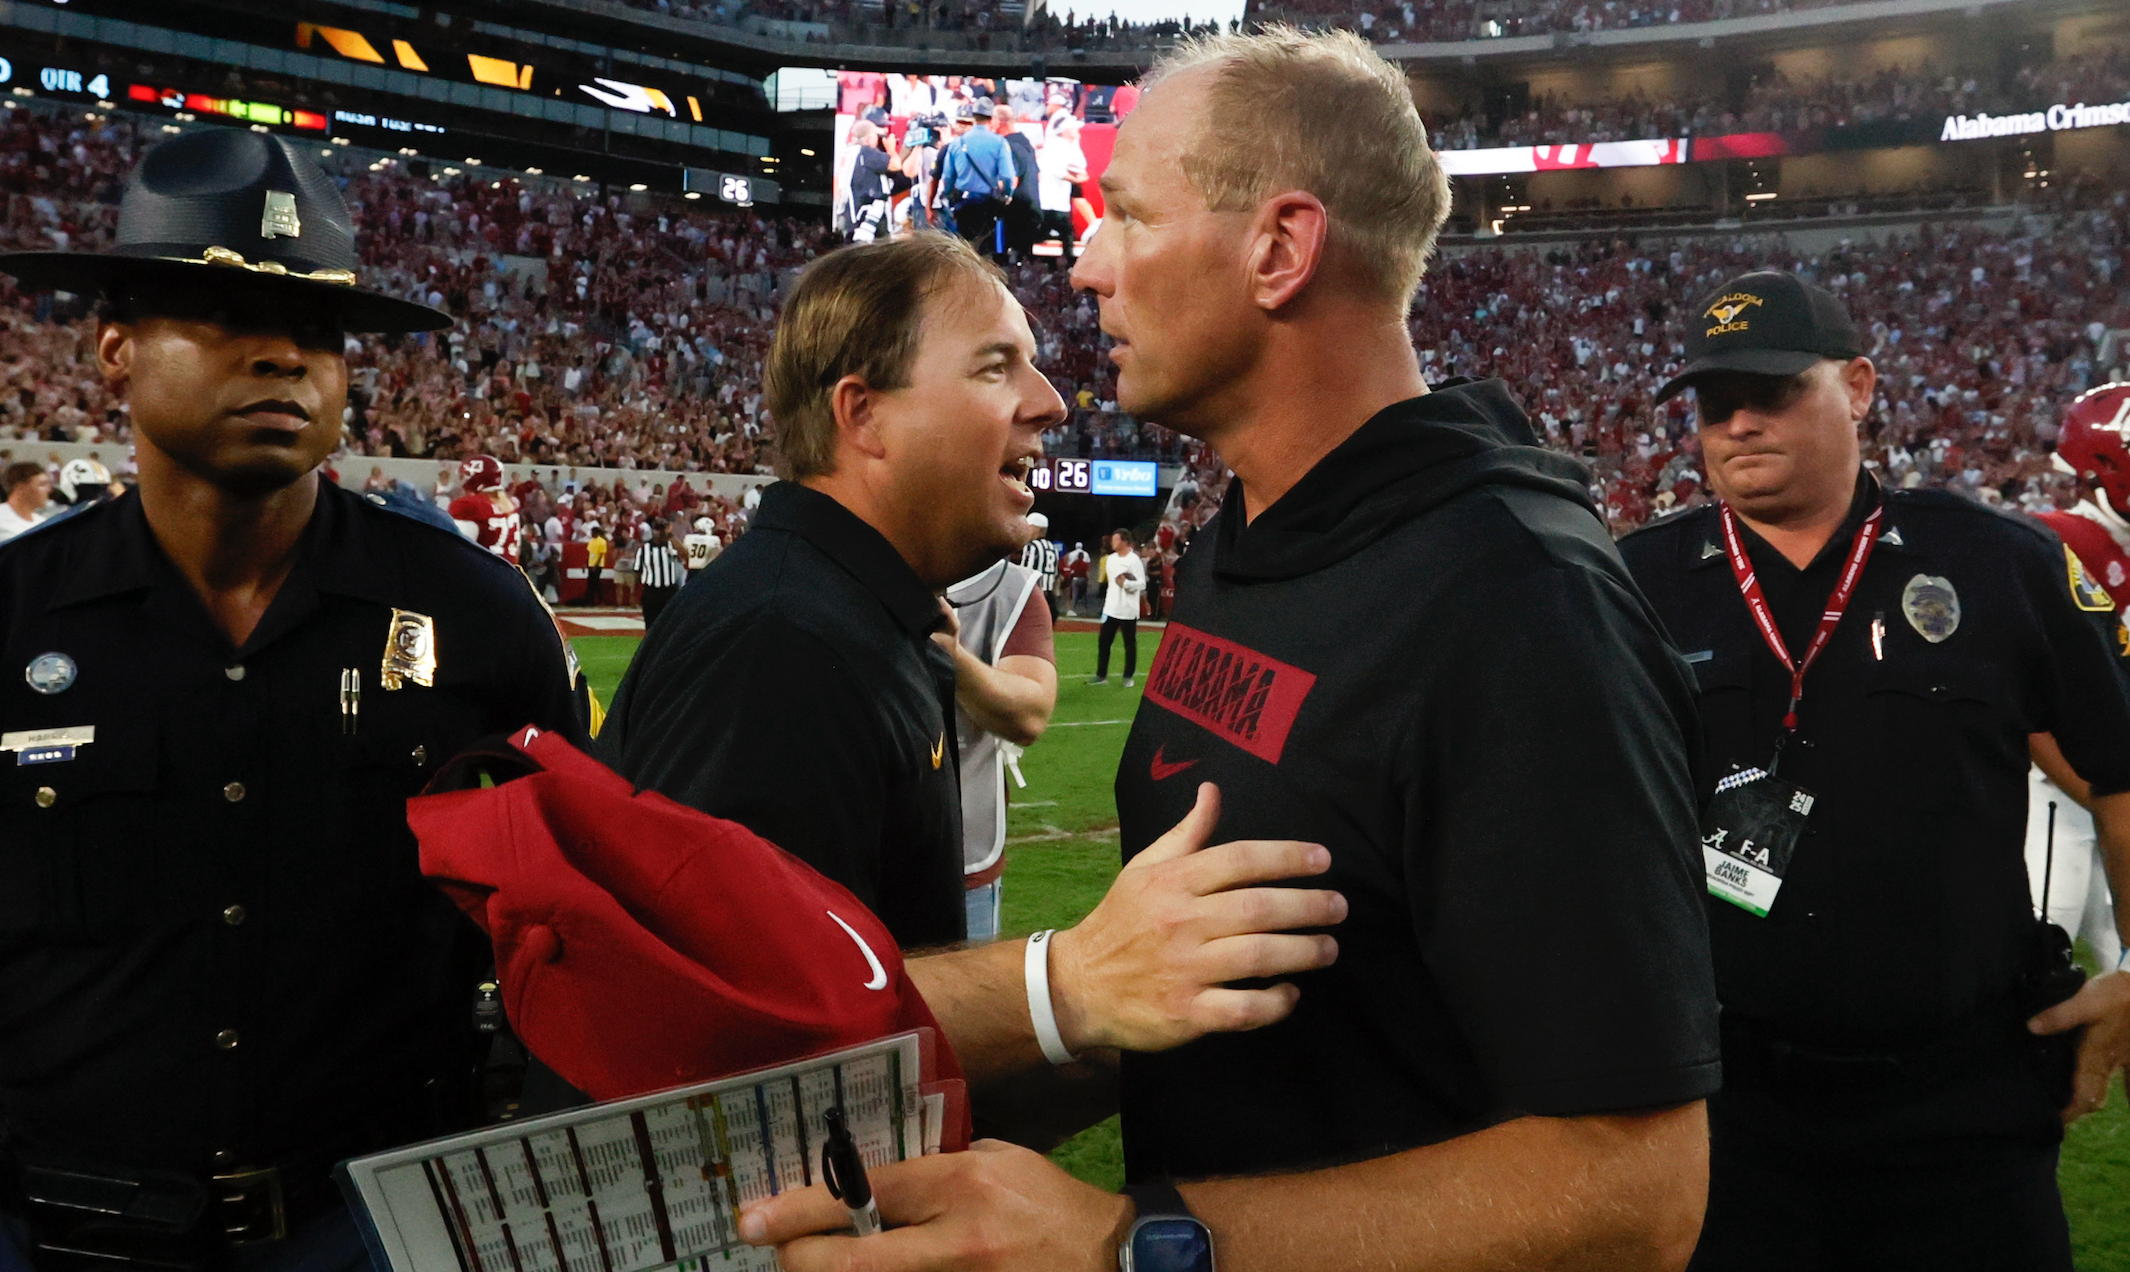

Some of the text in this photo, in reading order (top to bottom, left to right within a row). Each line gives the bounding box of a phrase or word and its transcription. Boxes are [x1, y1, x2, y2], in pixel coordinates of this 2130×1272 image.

[87, 73, 110, 99] 4
[1940, 112, 2047, 142] Alabama
[723, 177, 749, 201] 26
[1706, 321, 1749, 338] POLICE
[1032, 462, 1088, 489] 10 26
[488, 513, 520, 556] 73
[690, 543, 707, 559] 30
[1044, 550, 1056, 573] R
[1153, 633, 1277, 741] ALABAMA
[1740, 839, 1770, 866] F-A
[1714, 866, 1750, 888] BANKS
[1718, 860, 1751, 878] JAIME
